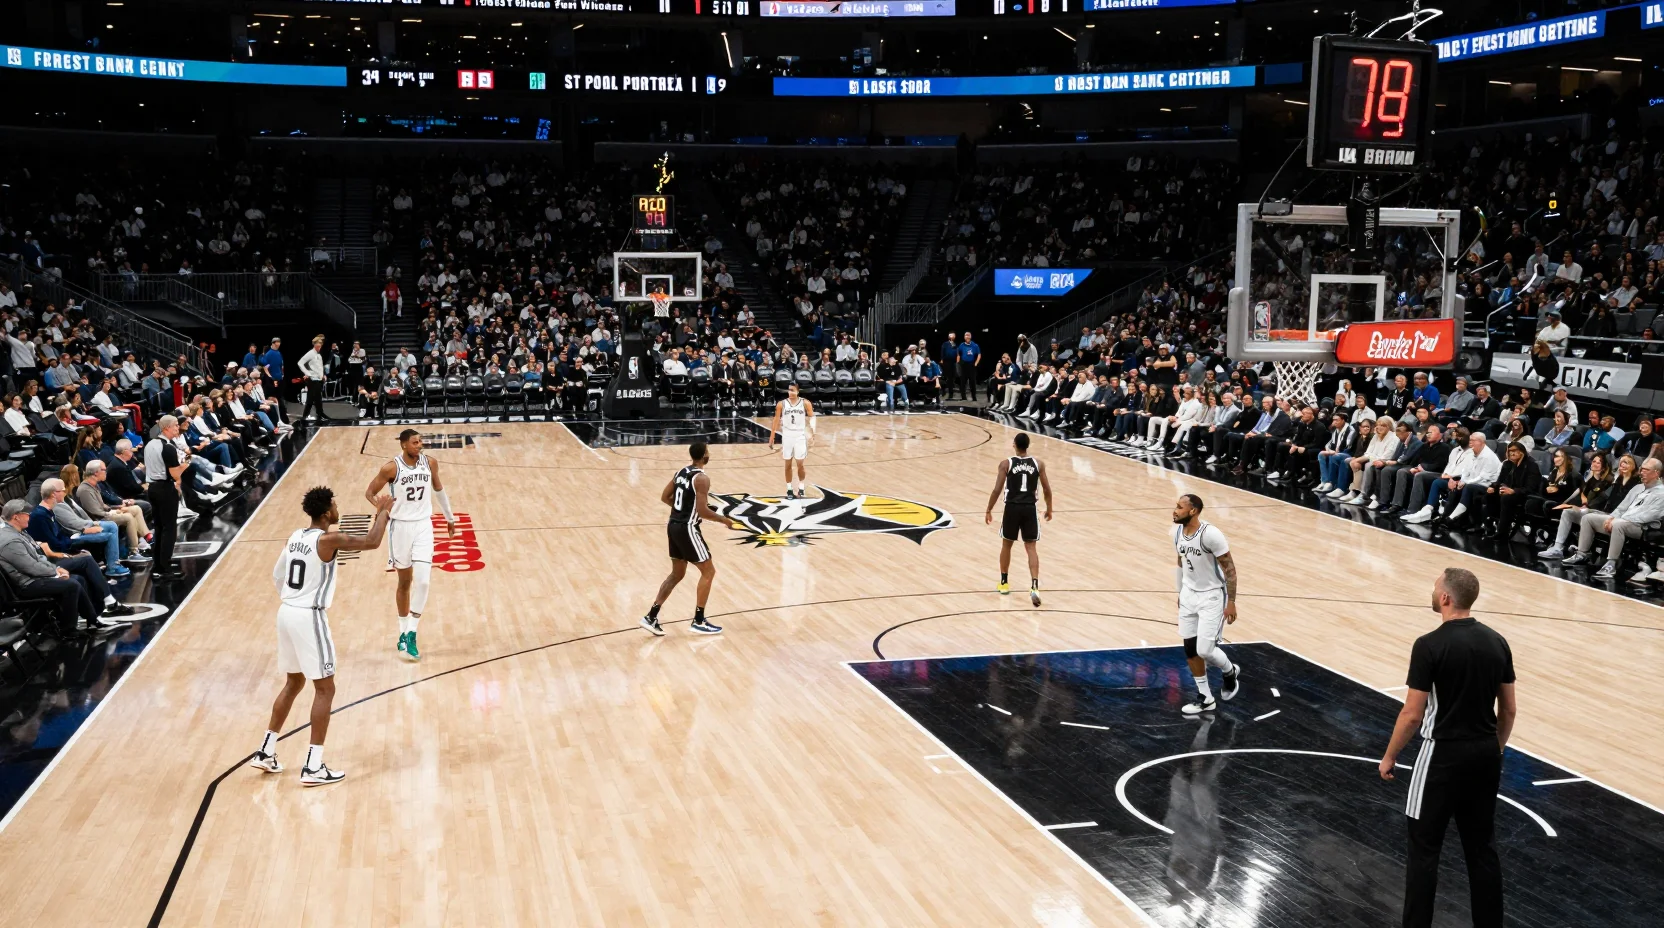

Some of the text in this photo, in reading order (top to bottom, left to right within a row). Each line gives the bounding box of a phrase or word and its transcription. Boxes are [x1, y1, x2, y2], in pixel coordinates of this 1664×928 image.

[565, 74, 581, 90] ST
[1019, 473, 1028, 492] 1
[405, 485, 425, 502] 27
[288, 558, 307, 590] 0
